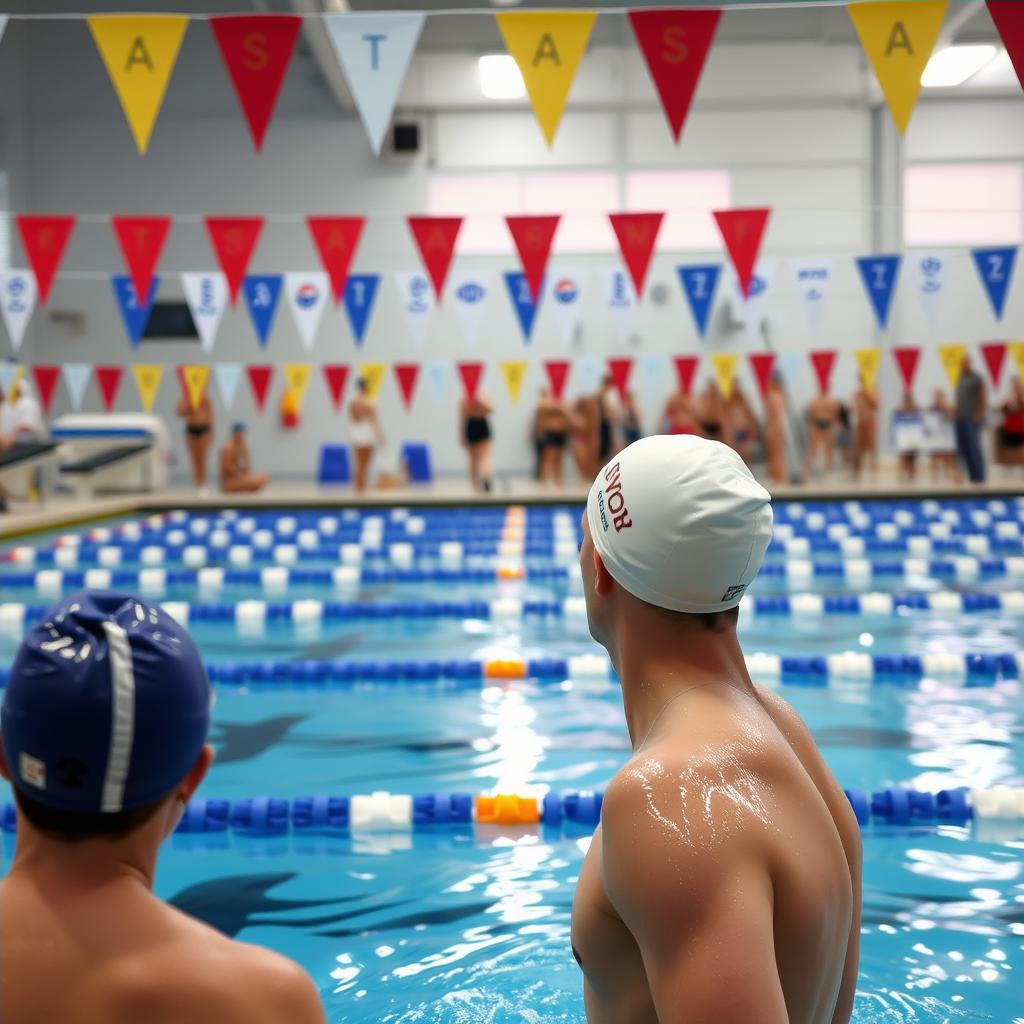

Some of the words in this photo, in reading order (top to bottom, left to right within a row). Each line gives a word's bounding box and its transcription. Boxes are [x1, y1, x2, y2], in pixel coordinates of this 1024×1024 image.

[124, 35, 155, 72] A
[242, 32, 269, 72] S
[362, 33, 388, 71] T
[531, 32, 562, 68] A
[661, 25, 689, 65] S
[884, 20, 915, 57] A
